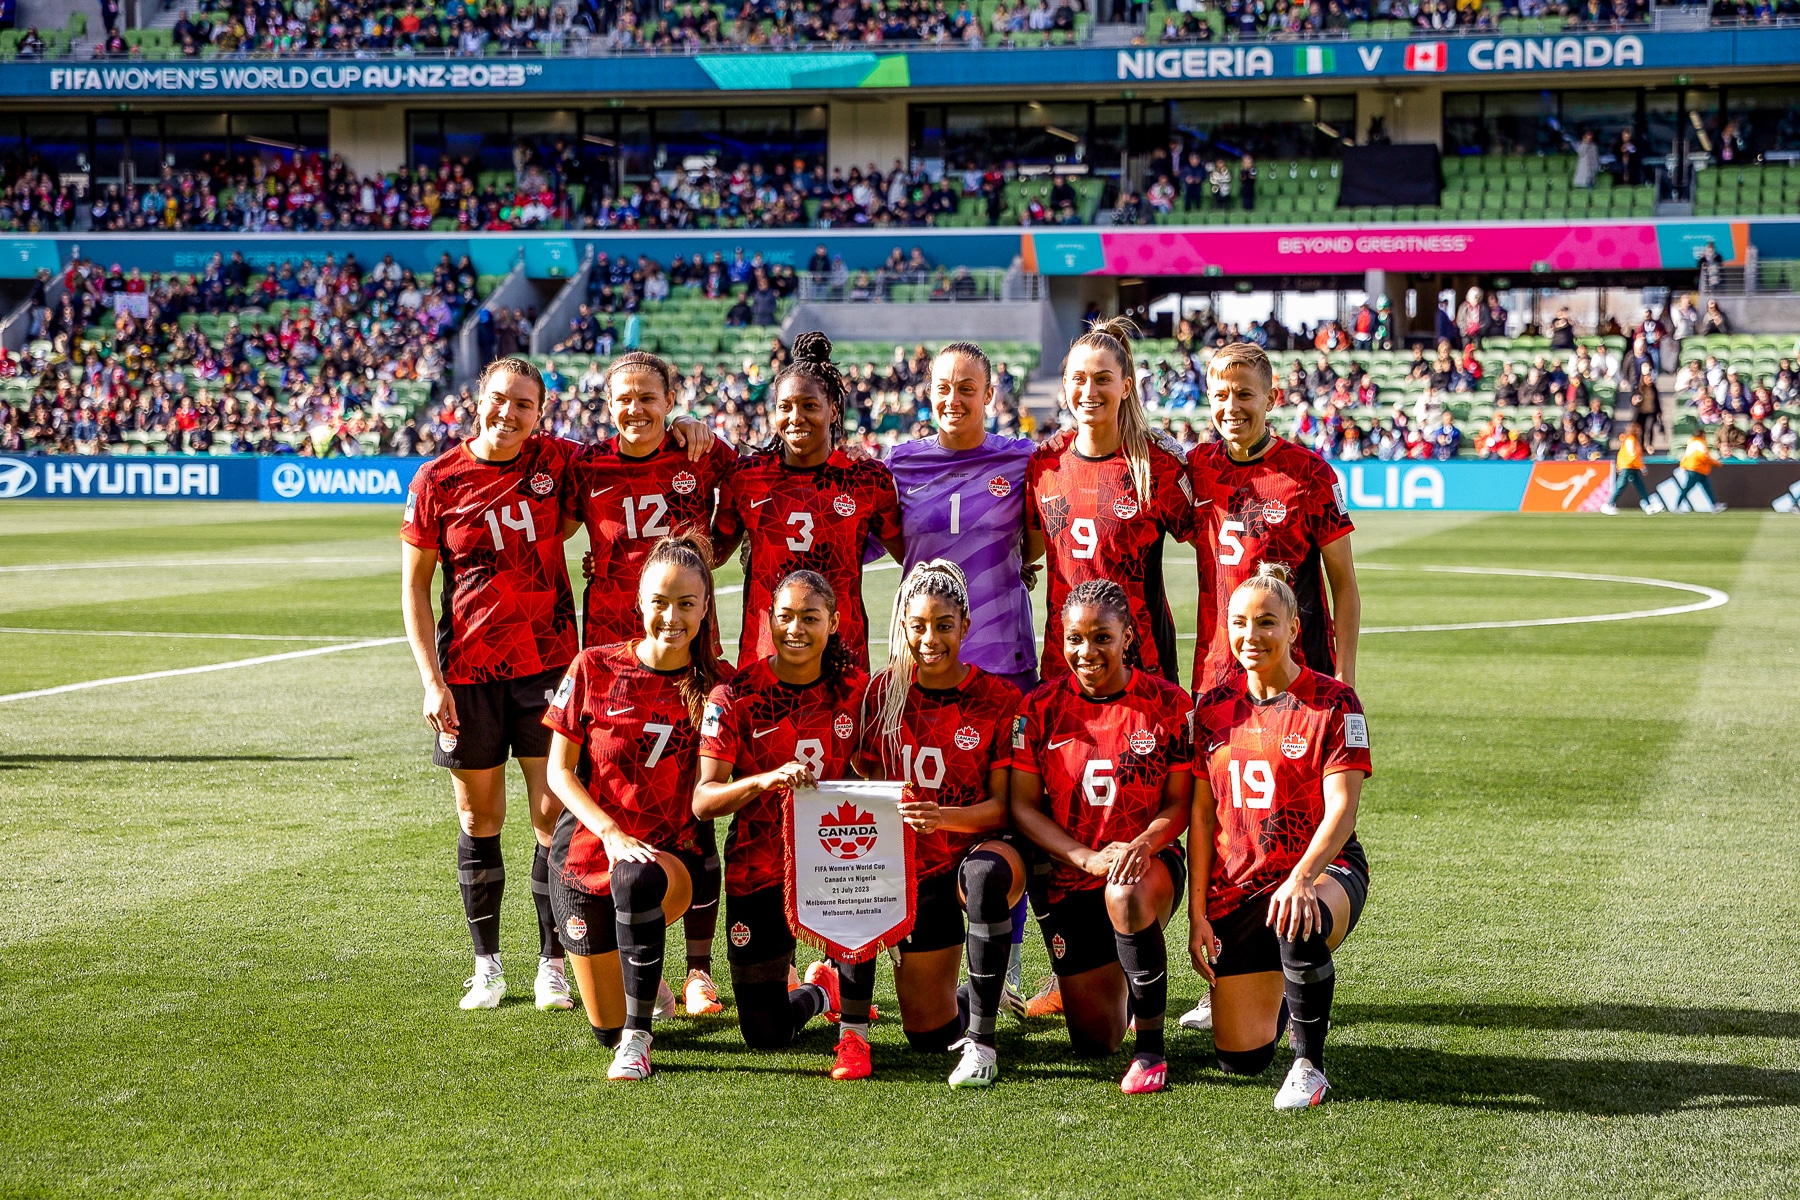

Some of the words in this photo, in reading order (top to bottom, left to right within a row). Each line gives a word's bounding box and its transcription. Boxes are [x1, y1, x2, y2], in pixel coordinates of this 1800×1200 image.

[50, 67, 102, 89] FIFA
[102, 67, 218, 89] WOMEN'S
[220, 66, 309, 89] WORLD
[310, 66, 361, 88] CUP
[1117, 47, 1273, 79] NIGERIA
[1357, 45, 1383, 71] V
[1468, 35, 1643, 70] CANADA
[1278, 236, 1353, 254] BEYOND
[45, 463, 219, 495] HYUNDAI
[306, 468, 402, 494] WANDA
[1336, 465, 1445, 508] LIA
[485, 500, 536, 550] 14
[622, 494, 670, 539] 12
[786, 512, 814, 551] 3
[949, 493, 961, 534] 1
[1070, 518, 1098, 559] 9
[1218, 521, 1246, 565] 5
[642, 722, 673, 768] 7
[794, 738, 825, 780] 8
[902, 745, 946, 789] 10
[1082, 759, 1117, 806] 6
[1228, 760, 1276, 809] 19
[818, 826, 878, 837] CANADA
[828, 864, 854, 872] Women's
[873, 863, 886, 871] Cup
[855, 875, 876, 883] Nigeria
[805, 899, 836, 907] Melbourne
[837, 897, 872, 905] Rectangular
